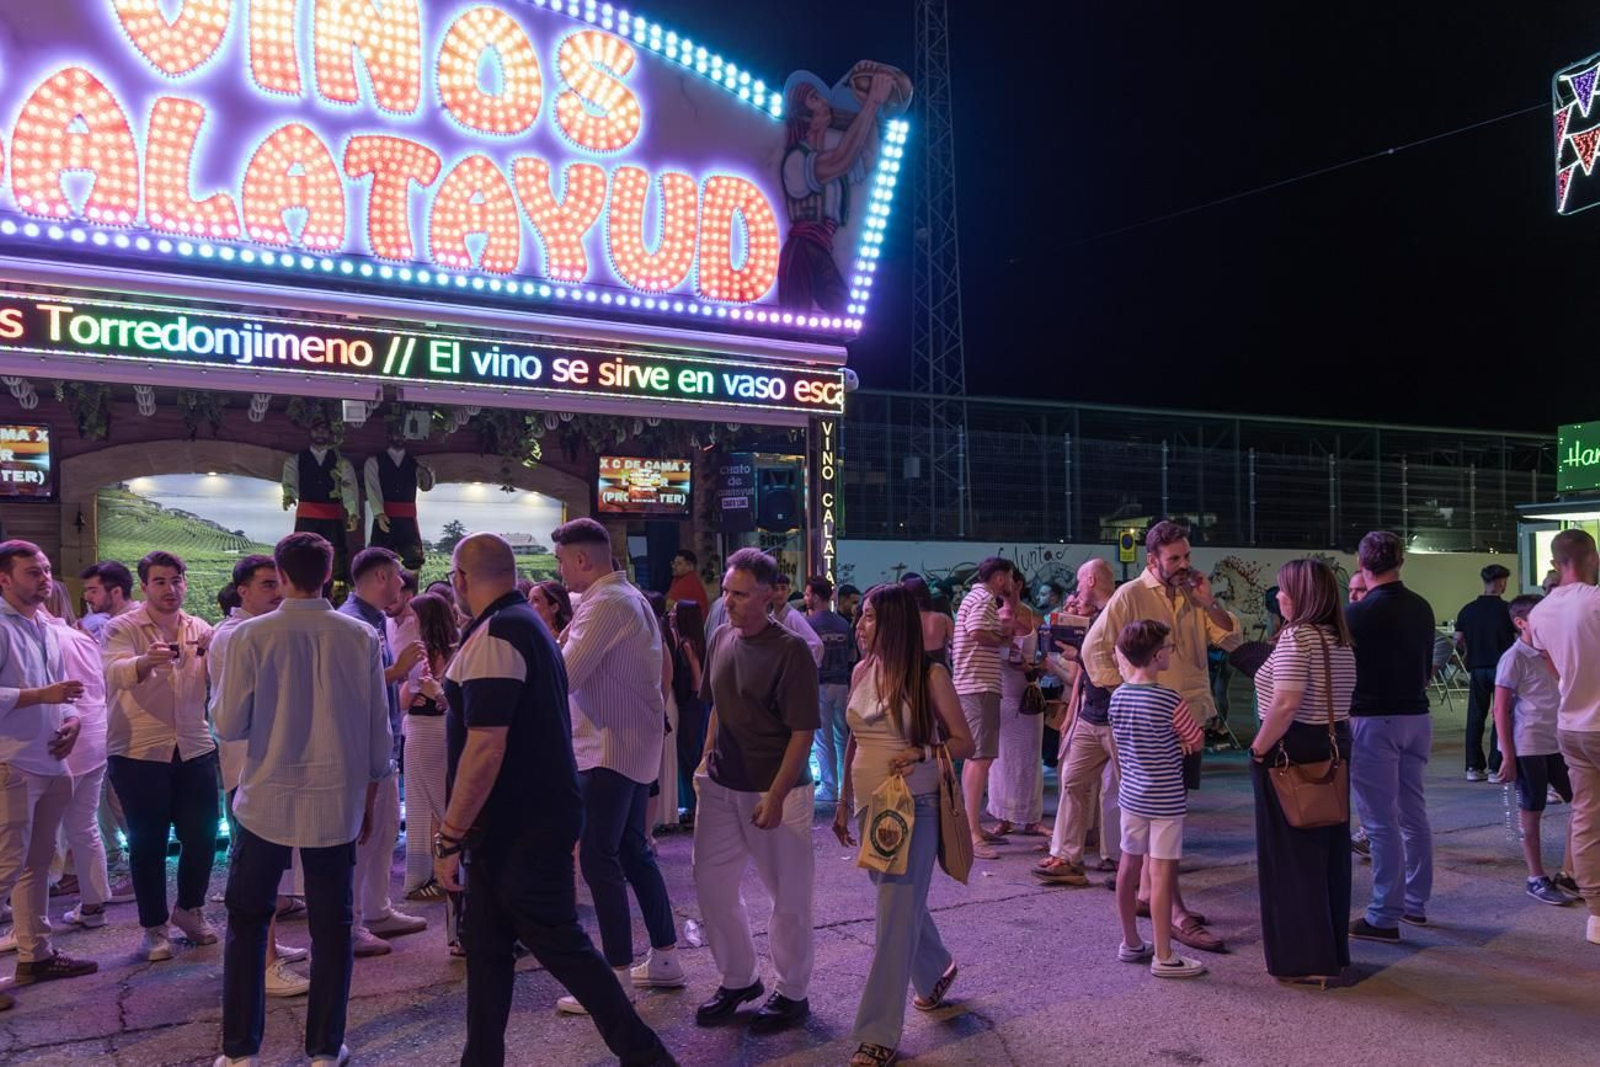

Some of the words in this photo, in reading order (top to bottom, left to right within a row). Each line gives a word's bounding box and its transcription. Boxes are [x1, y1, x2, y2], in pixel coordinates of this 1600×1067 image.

[0, 66, 781, 304] ALATAYUD
[36, 304, 373, 366] Torredonjimeno
[382, 336, 416, 375] //
[430, 340, 460, 374] El
[471, 346, 542, 380] vino
[552, 358, 589, 383] se
[598, 357, 670, 390] sirve
[681, 369, 714, 394] en
[723, 373, 786, 400] vaso
[624, 460, 642, 470] DE
[644, 461, 680, 472] CAMA
[822, 421, 834, 481] VINO
